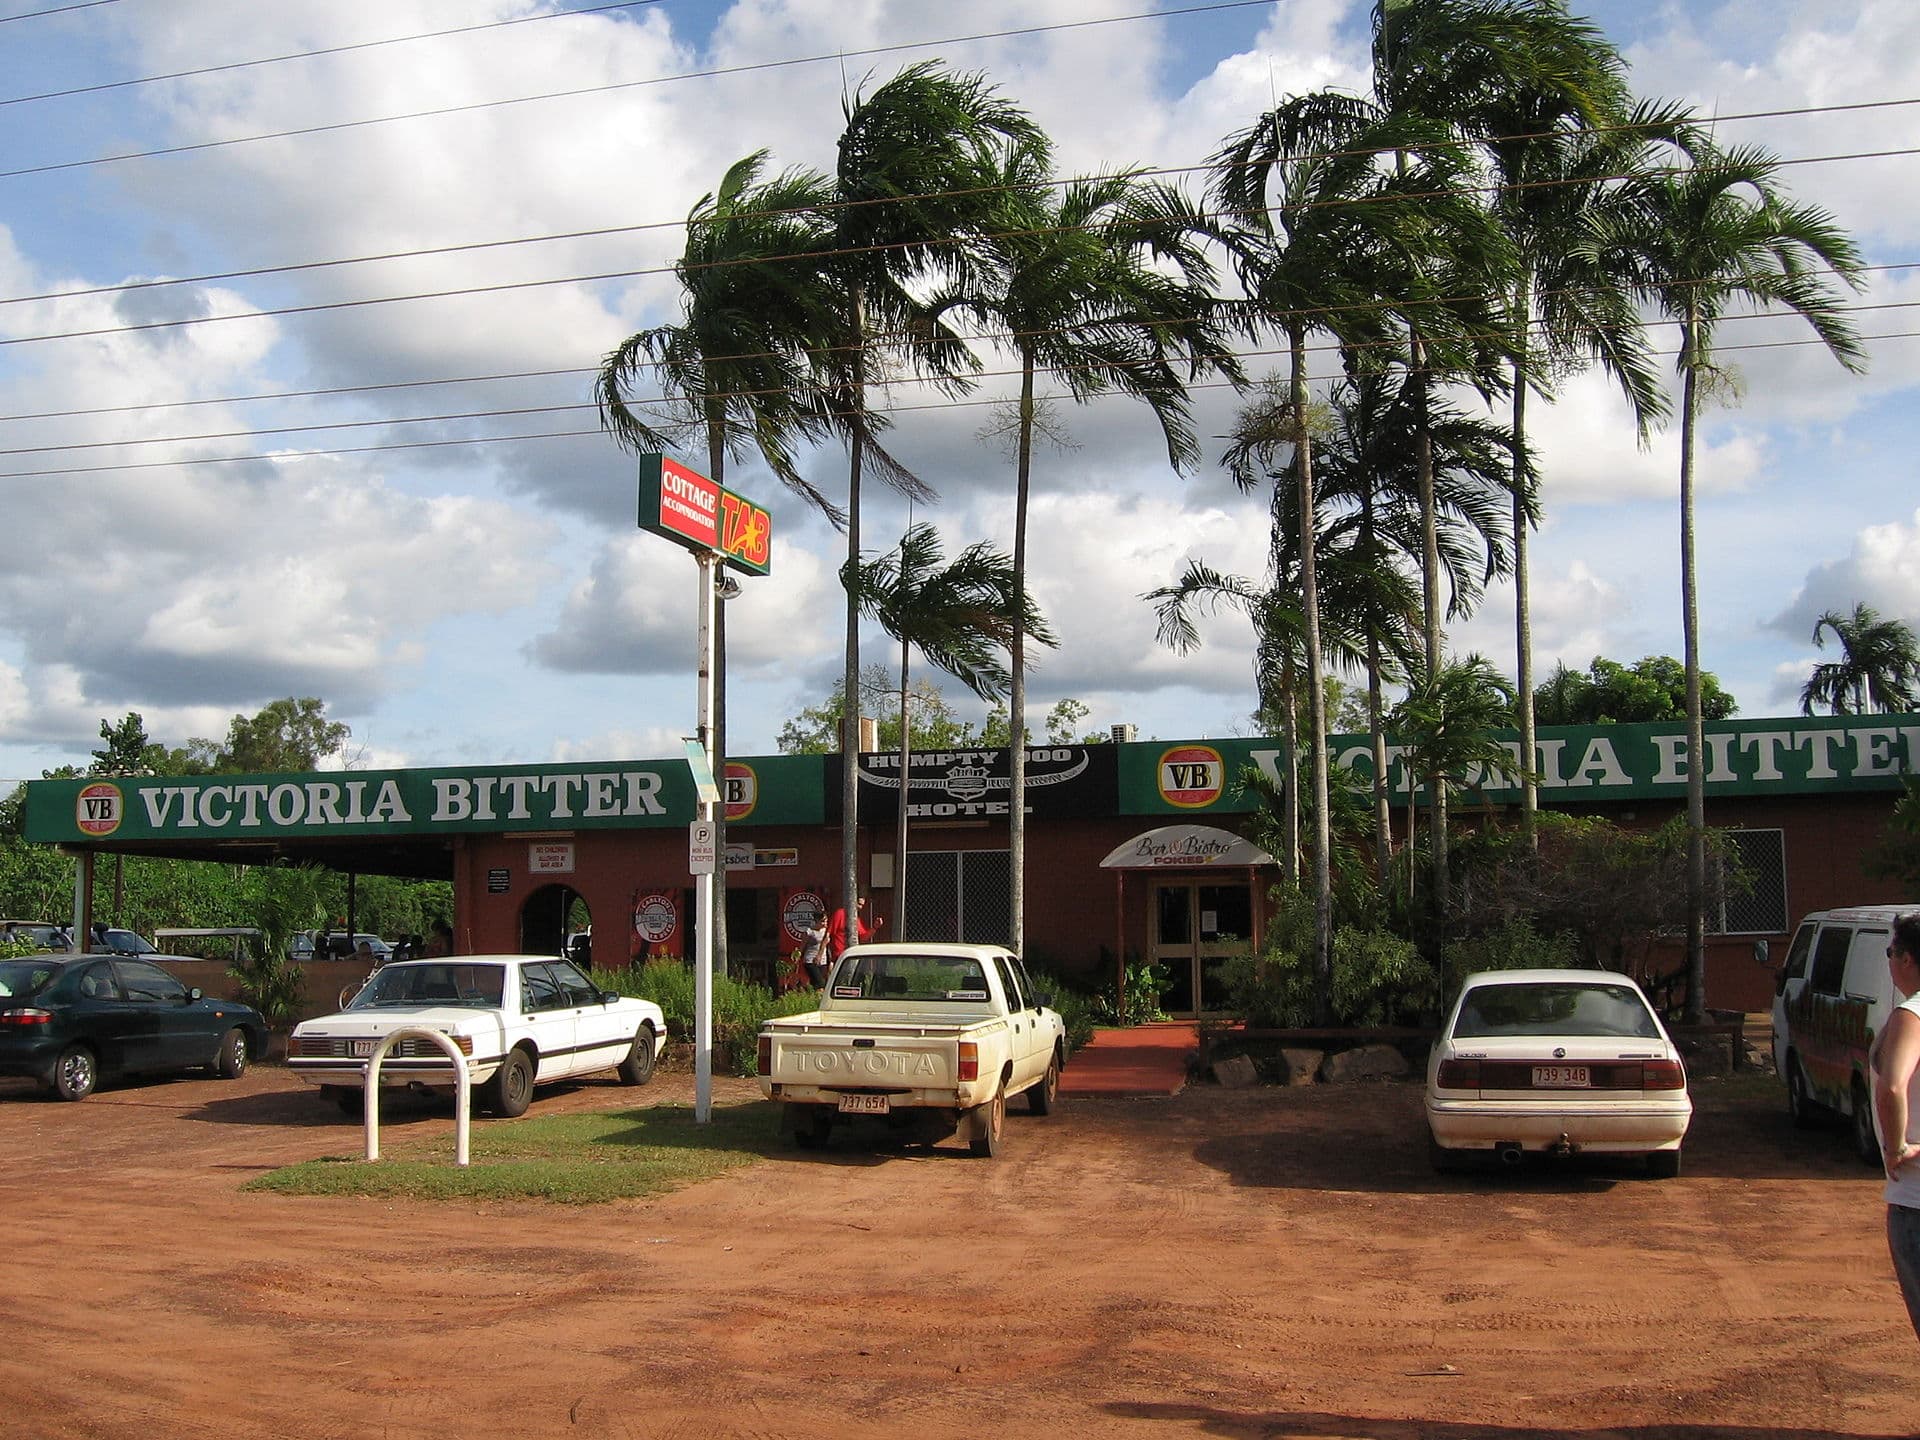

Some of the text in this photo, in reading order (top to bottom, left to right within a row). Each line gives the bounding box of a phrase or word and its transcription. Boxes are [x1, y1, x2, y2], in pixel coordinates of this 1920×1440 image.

[663, 471, 715, 513] COTTAGE
[662, 496, 714, 530] ACCOMMODATION
[721, 492, 770, 566] TAB
[868, 752, 998, 768] HUMPTY
[1168, 764, 1212, 788] VB
[139, 772, 666, 828] VICTORIA BITTER
[726, 780, 746, 802] B
[85, 799, 113, 820] VB
[699, 830, 707, 840] P
[1136, 837, 1169, 857] Bar
[1182, 835, 1232, 856] Bistro
[1154, 857, 1204, 865] POKIES
[641, 897, 672, 909] CARLTON
[790, 894, 818, 906] CARLTON
[793, 1050, 936, 1076] TOYOTA
